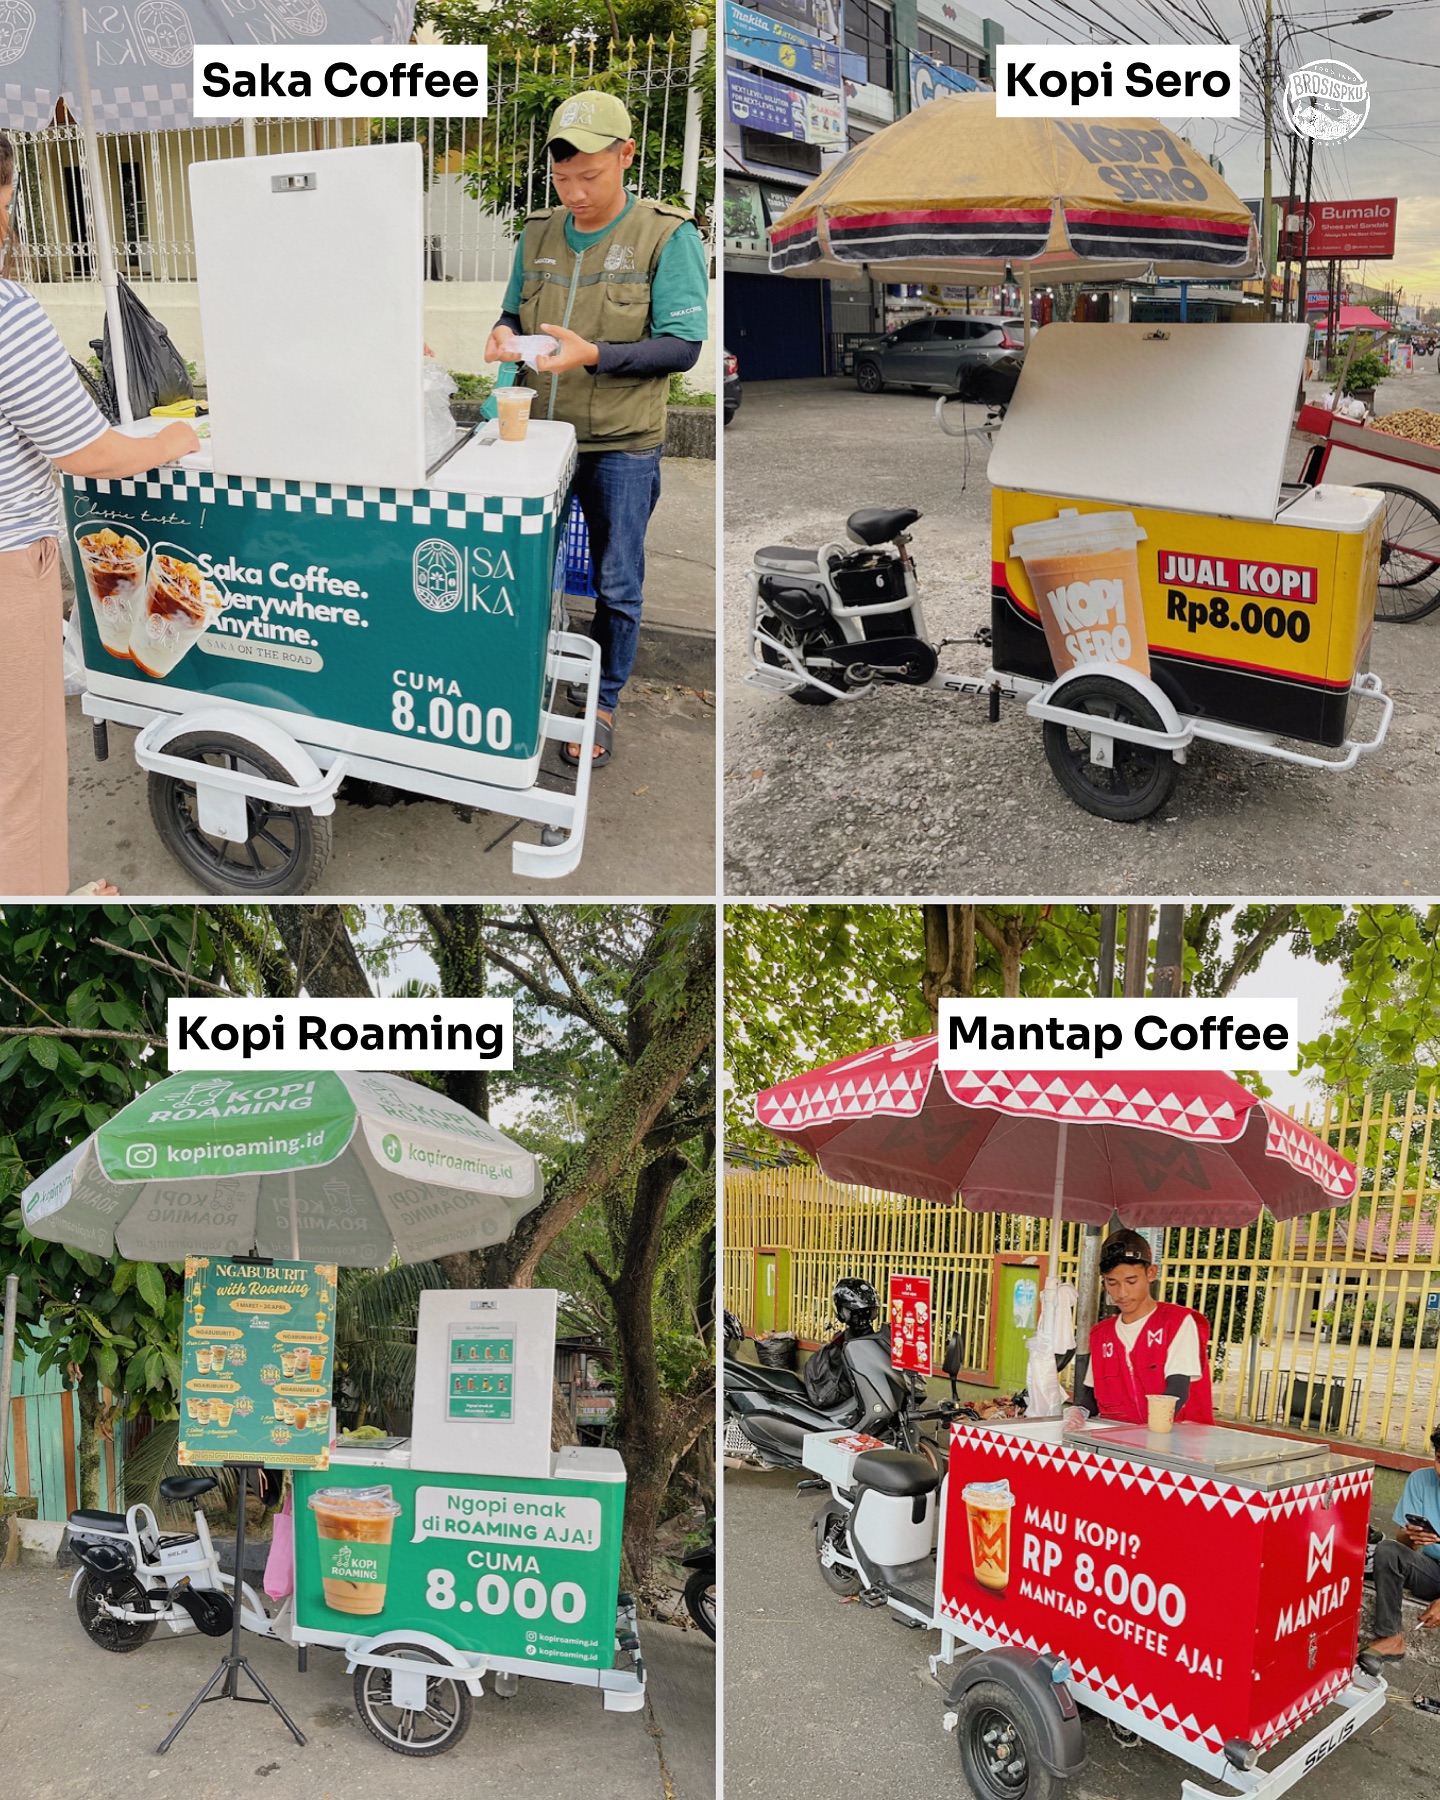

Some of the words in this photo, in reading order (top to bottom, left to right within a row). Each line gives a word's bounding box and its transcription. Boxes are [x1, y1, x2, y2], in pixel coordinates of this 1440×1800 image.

[731, 6, 770, 31] makita
[1053, 120, 1187, 168] KOPI
[1098, 165, 1209, 203] SERO
[1321, 205, 1391, 220] Bumalo
[198, 553, 263, 586] Saka
[269, 562, 369, 599] Coffee.
[472, 547, 515, 580] SA
[1163, 555, 1229, 588] JUAL
[1238, 562, 1312, 598] KOPI
[875, 574, 885, 588] 6
[200, 580, 369, 628] Everywhere.
[472, 583, 515, 617] KA
[1046, 578, 1127, 635] KOPI
[1167, 590, 1311, 644] Rp8.000
[202, 607, 319, 647] Anytime.
[207, 638, 235, 652] SAKA
[237, 644, 253, 655] ON
[257, 647, 280, 661] THE
[282, 651, 313, 665] ROAD
[1065, 625, 1132, 668] SERO
[393, 669, 462, 698] CUMA
[943, 680, 1019, 700] SELS
[392, 690, 512, 751] 8.000
[147, 1096, 313, 1123] ROAMING
[226, 1081, 316, 1104] KOPI
[167, 1130, 326, 1164] kopiroaming.id
[409, 1143, 513, 1180] kopiroaming.id
[216, 1264, 308, 1281] NGABUBURIT
[216, 1282, 247, 1296] with
[248, 1281, 311, 1298] Roaming
[447, 1494, 507, 1517] Ngopi
[513, 1502, 566, 1519] enak
[422, 1515, 440, 1532] di
[445, 1518, 538, 1540] ROAMING
[543, 1527, 593, 1545] AJA!
[1024, 1503, 1067, 1535] MAU
[1074, 1518, 1141, 1560] KOPI?
[331, 1566, 378, 1580] ROAMING
[351, 1558, 377, 1570] KOPI
[466, 1550, 541, 1574] CUMA
[425, 1568, 587, 1624] 8.000
[1022, 1533, 1063, 1577] RP
[1074, 1553, 1187, 1628] 8.000
[1275, 1576, 1350, 1642] MANTAP
[539, 1633, 599, 1647] kopiroaming.id
[1019, 1578, 1088, 1620] MANTAP
[1093, 1608, 1169, 1657] COFFEE
[1175, 1644, 1224, 1681] AJA!
[539, 1648, 598, 1662] kopiroaming.id
[1302, 1717, 1357, 1774] SELIS
